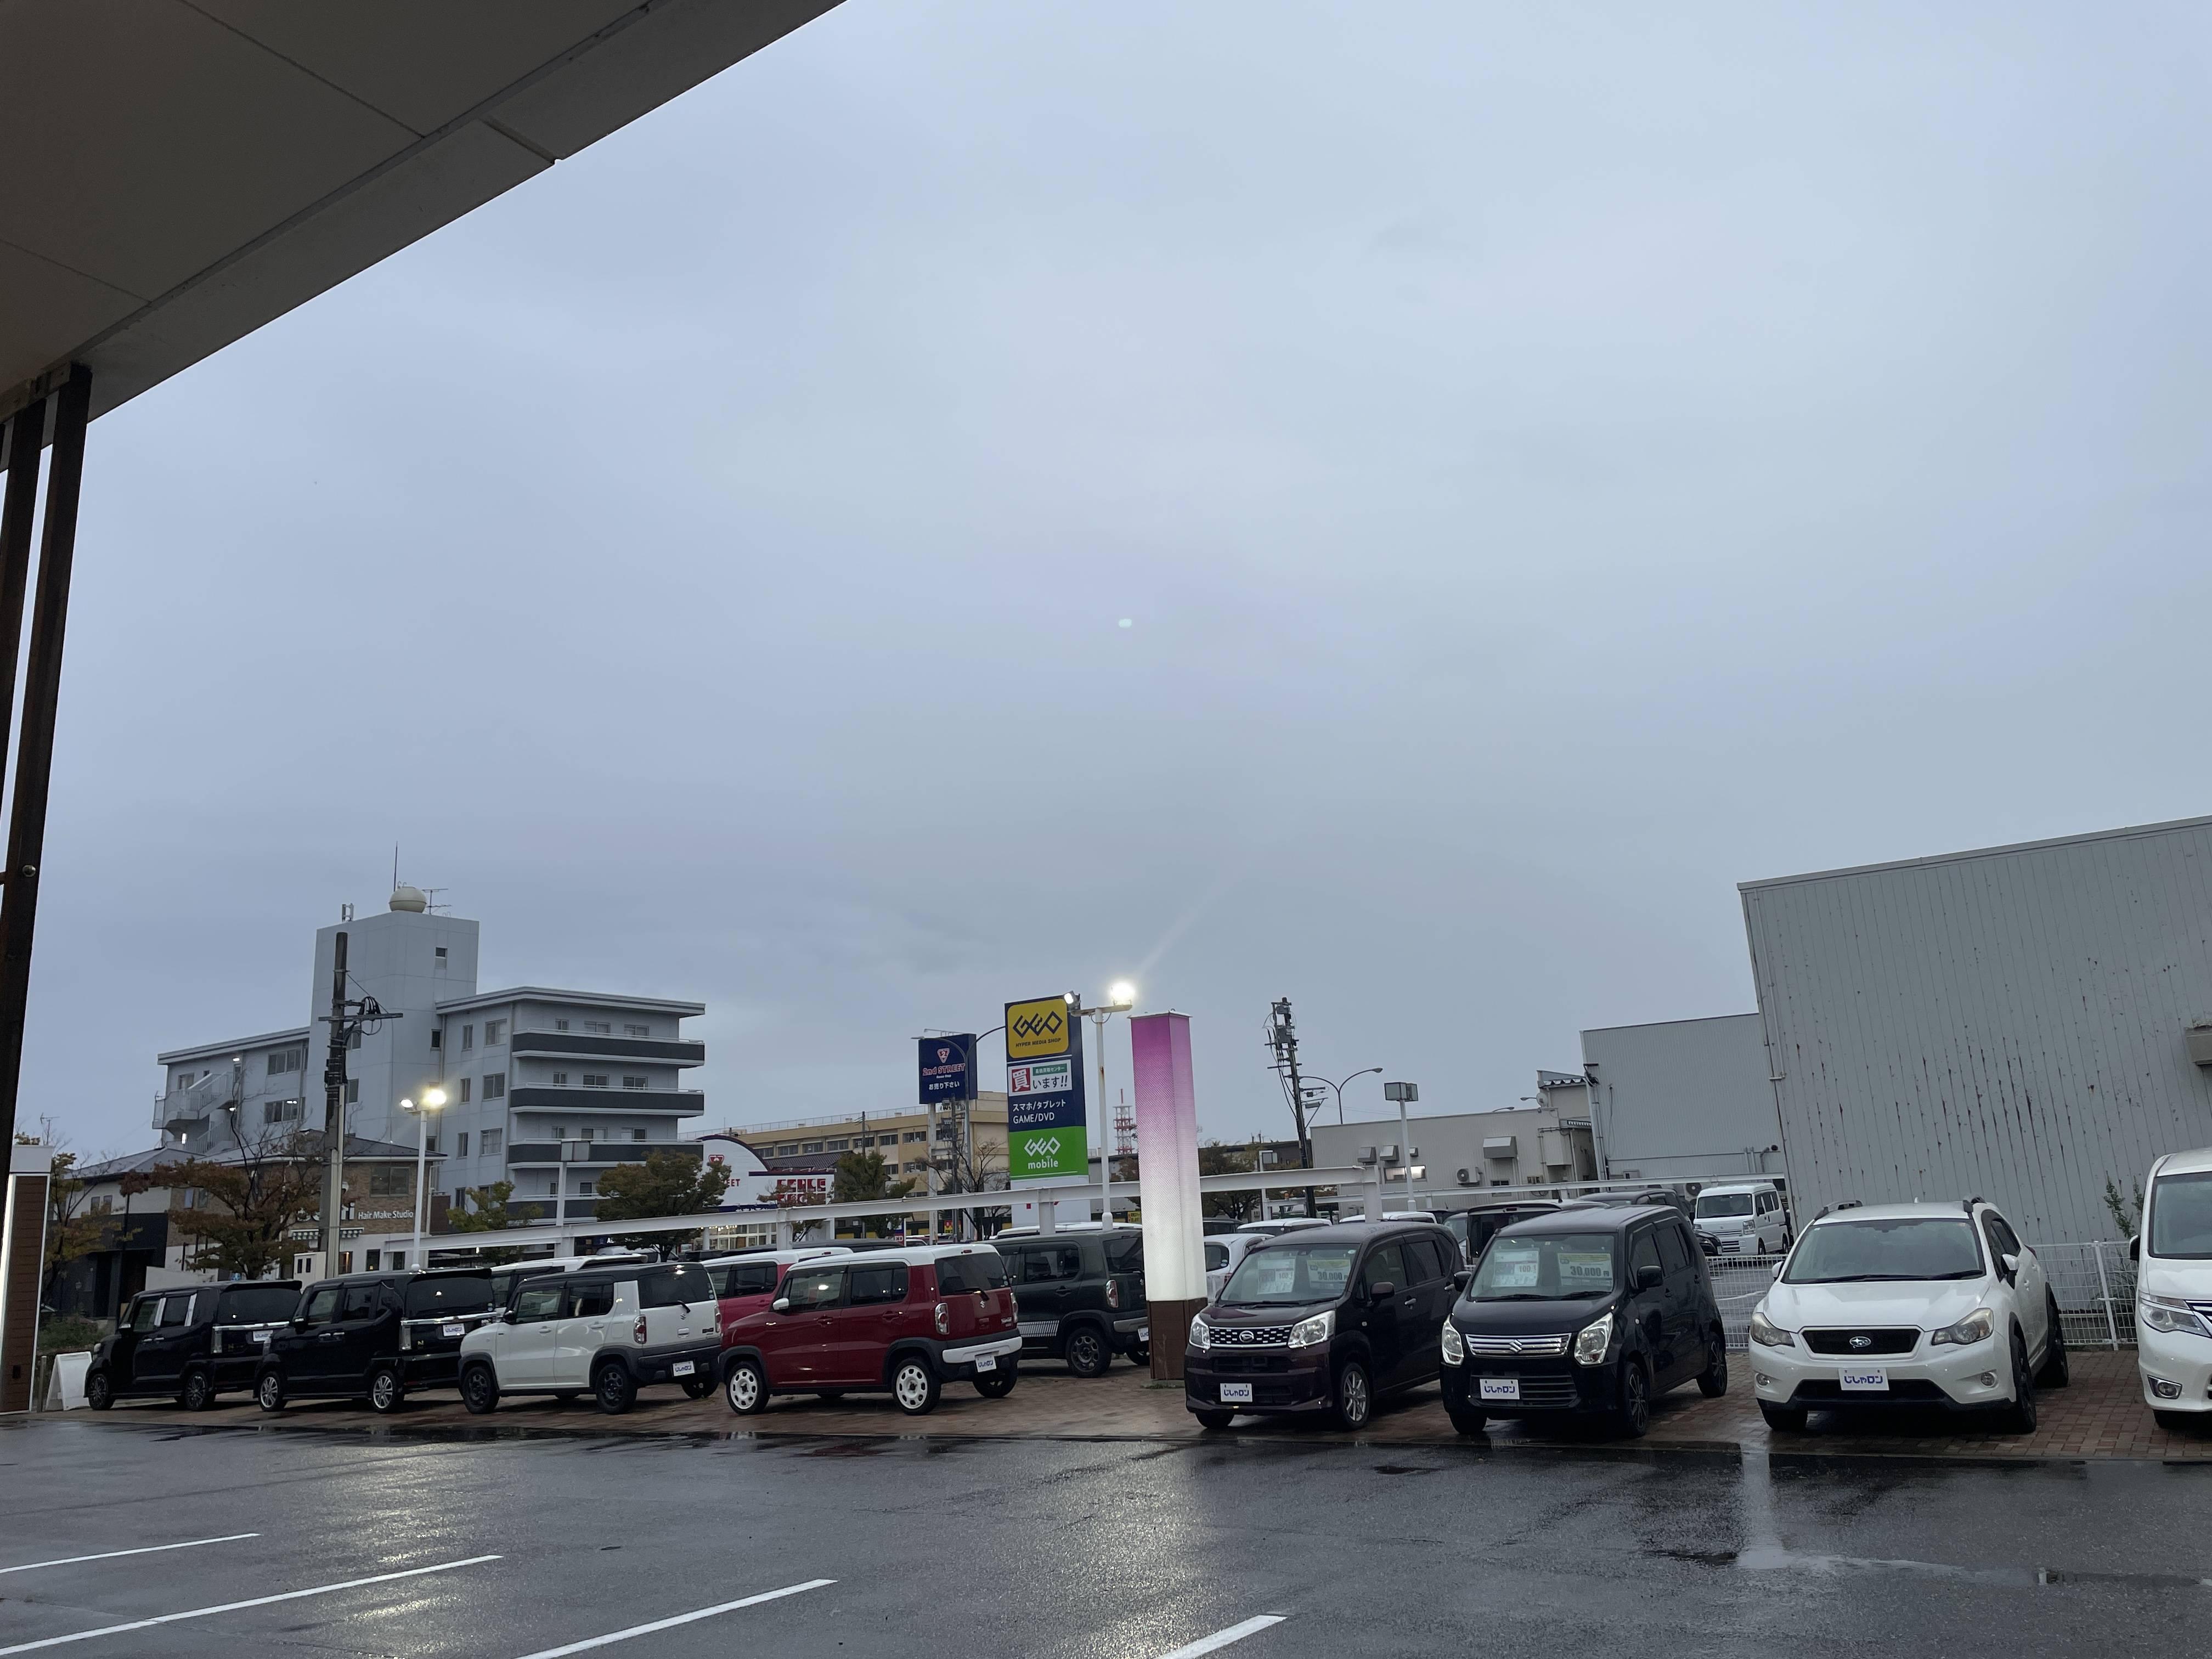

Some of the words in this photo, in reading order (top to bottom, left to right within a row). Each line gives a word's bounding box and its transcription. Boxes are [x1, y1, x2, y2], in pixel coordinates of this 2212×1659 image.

[1013, 1011, 1063, 1039] GEO
[922, 1066, 937, 1076] 2nd
[938, 1063, 966, 1074] STREET
[1013, 1099, 1066, 1111] スマホ/タブレット
[1013, 1112, 1054, 1124] GAME/DVD
[1024, 1136, 1061, 1157] GEO
[1028, 1158, 1058, 1169] mobile
[358, 1211, 373, 1220] Hair
[374, 1210, 392, 1219] Make
[393, 1209, 413, 1218] Studio
